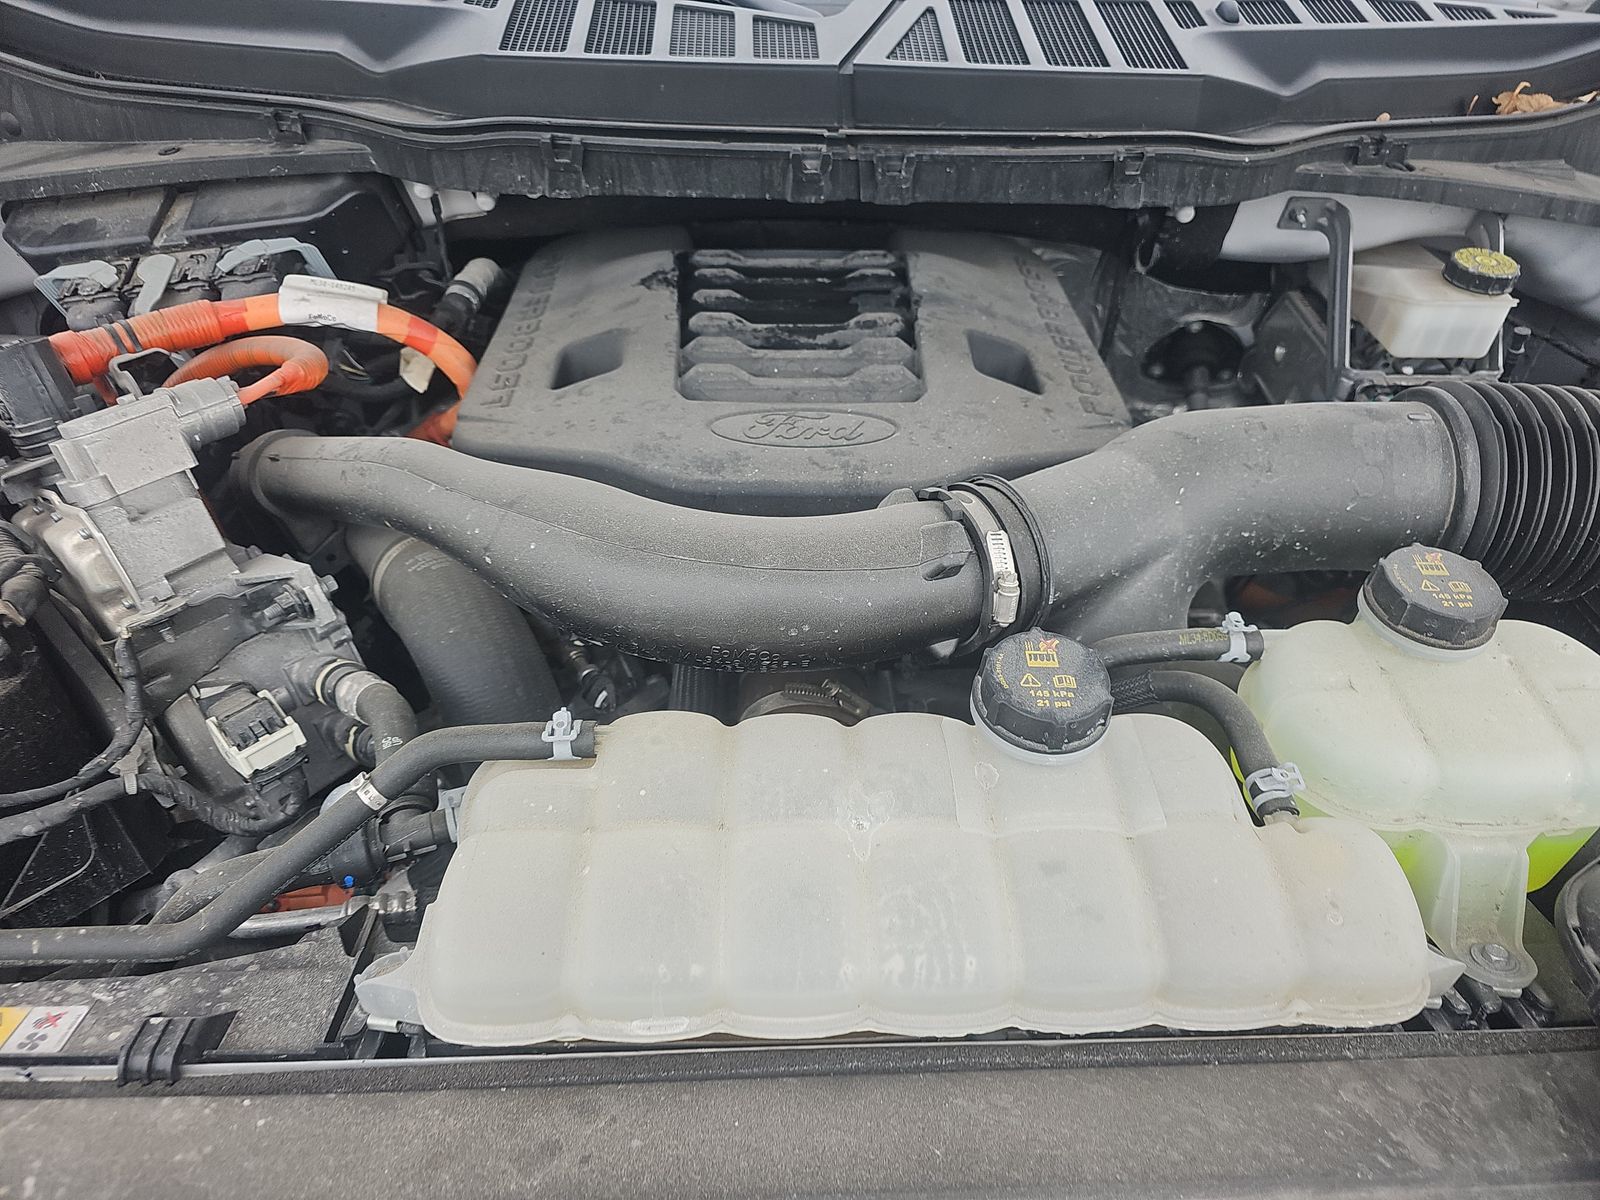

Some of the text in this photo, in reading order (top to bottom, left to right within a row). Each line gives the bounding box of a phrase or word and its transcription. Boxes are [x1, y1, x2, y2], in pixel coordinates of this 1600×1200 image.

[479, 254, 563, 408] OWERBOOST
[743, 412, 865, 440] Ford
[1030, 690, 1075, 698] 145 kPa
[1037, 699, 1072, 708] 21 psi
